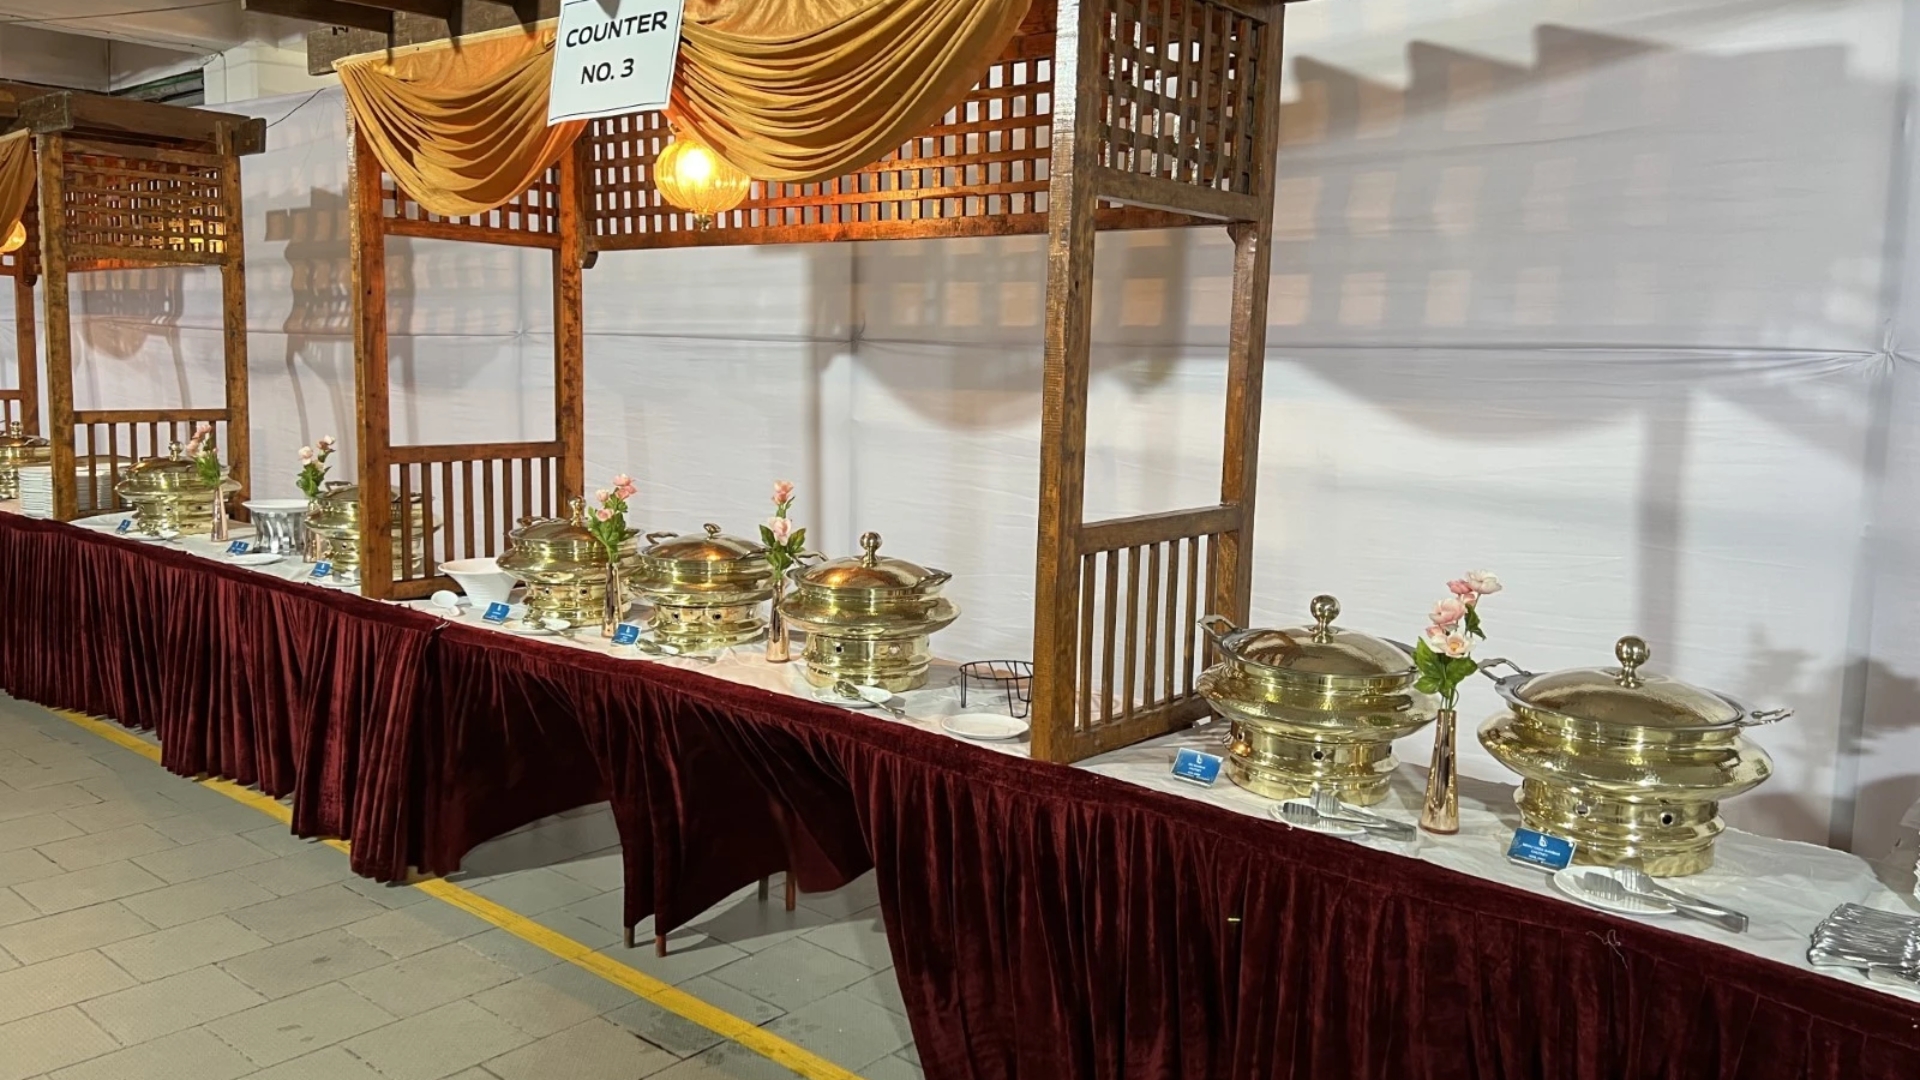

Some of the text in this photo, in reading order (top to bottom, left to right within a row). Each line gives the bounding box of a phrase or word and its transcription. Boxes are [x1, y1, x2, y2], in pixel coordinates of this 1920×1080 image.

[566, 11, 668, 48] COUNTER
[581, 58, 634, 85] NO. 3
